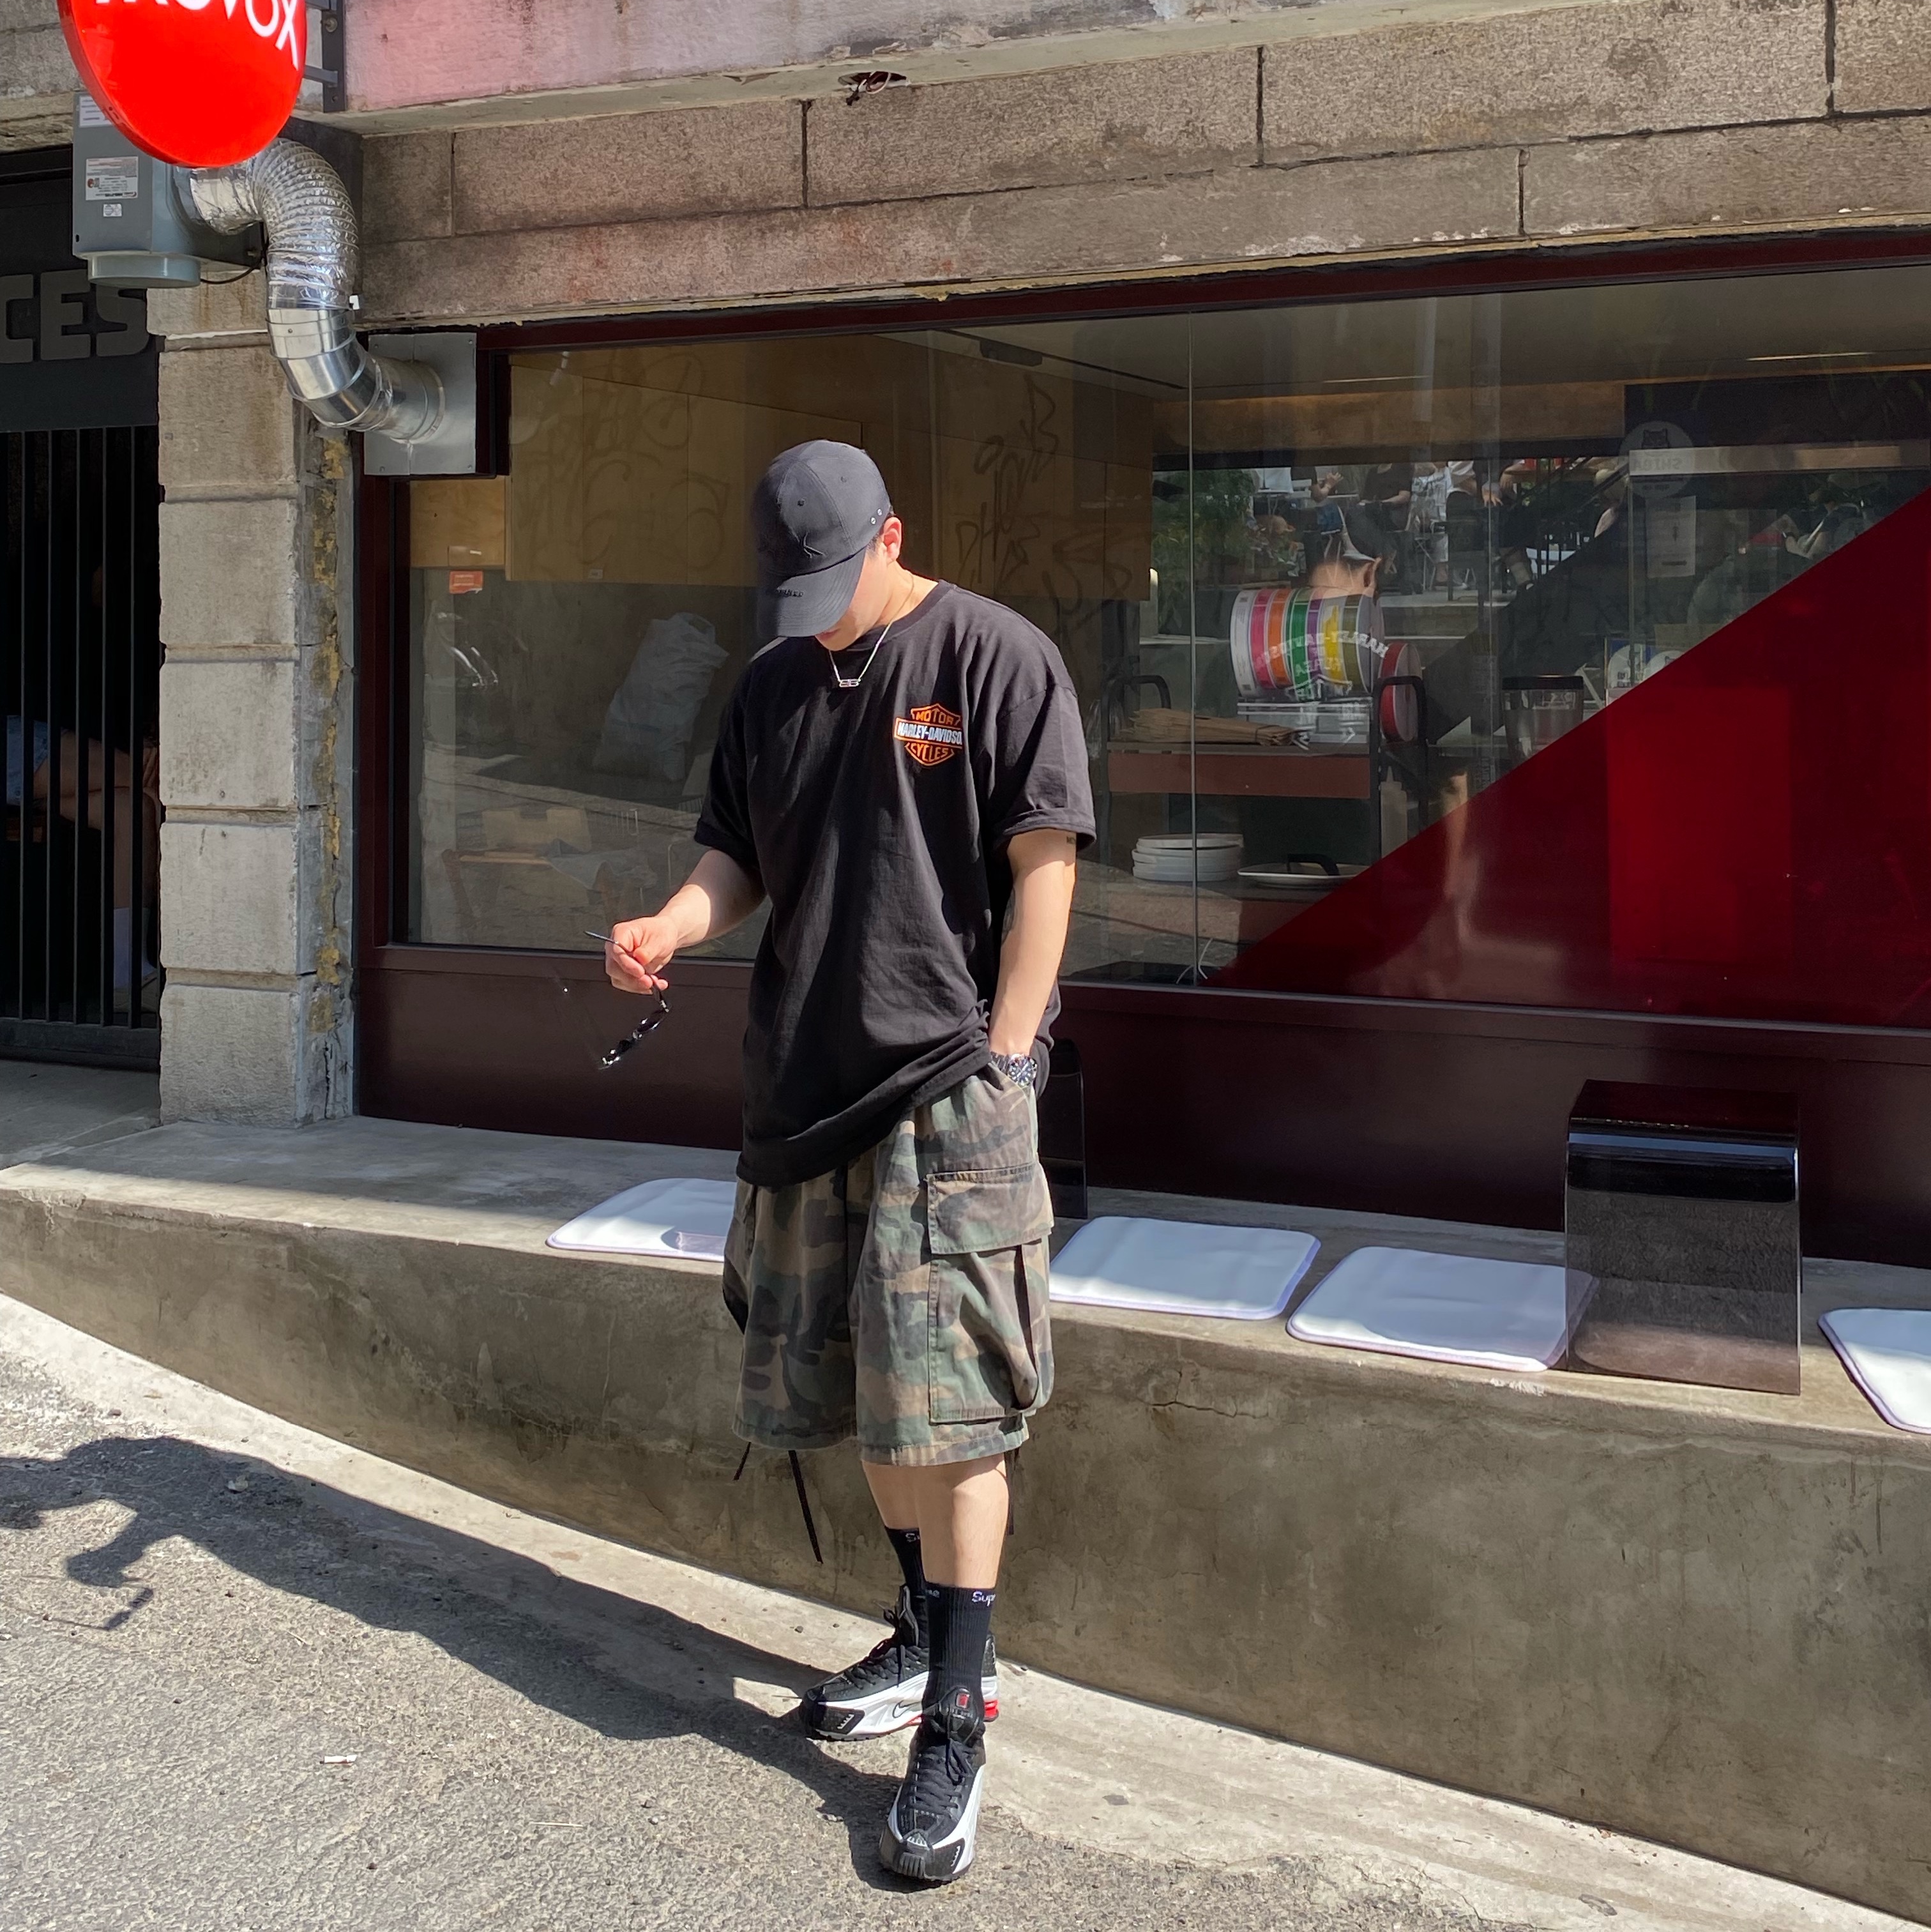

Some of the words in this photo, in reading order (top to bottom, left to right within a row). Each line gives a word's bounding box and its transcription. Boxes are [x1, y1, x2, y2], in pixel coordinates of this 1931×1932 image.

[916, 708, 954, 726] MOTOR
[897, 722, 962, 745] HARLEY-DAVIDSO
[911, 743, 949, 763] CYCLES
